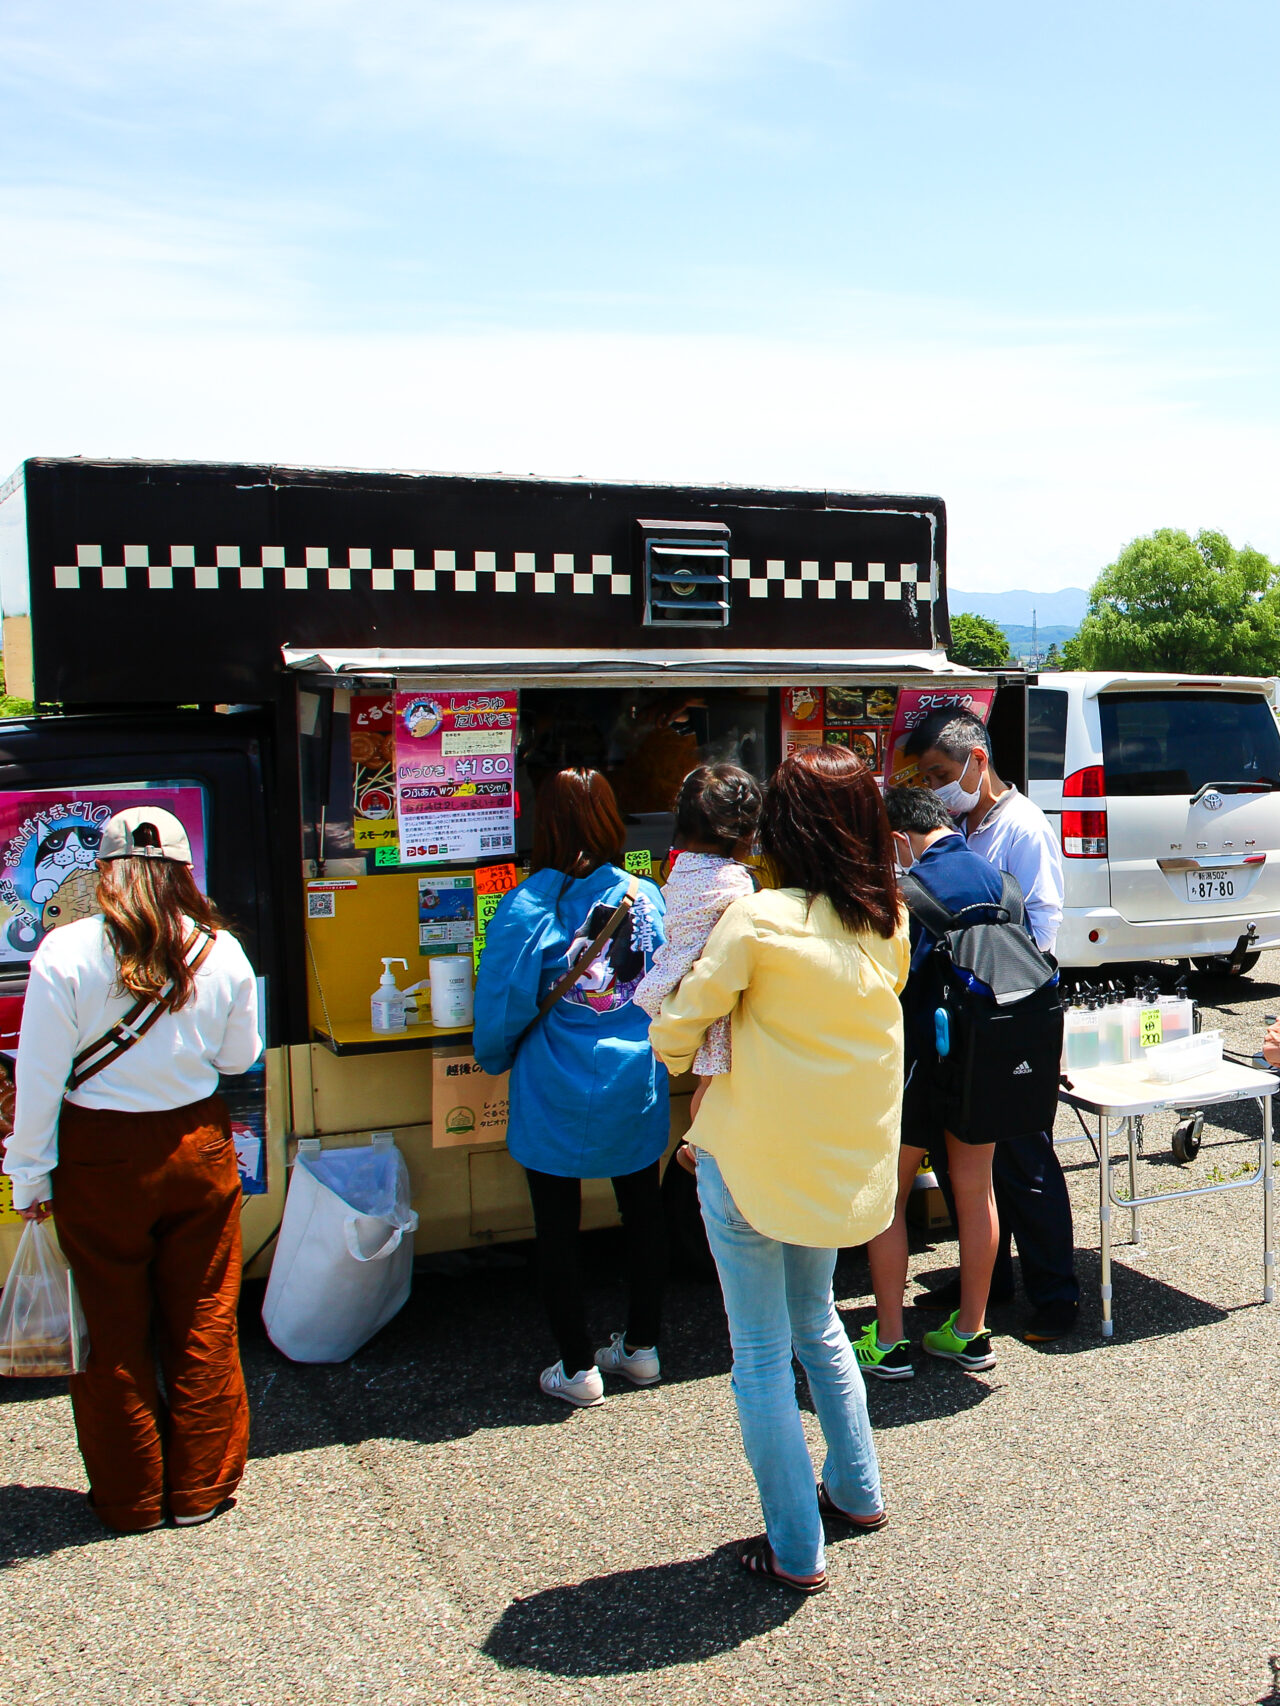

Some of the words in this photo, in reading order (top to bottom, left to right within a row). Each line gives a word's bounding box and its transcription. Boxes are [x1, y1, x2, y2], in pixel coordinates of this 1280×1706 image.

[450, 696, 505, 712] しょうゆ
[918, 693, 973, 709] タピオカ
[400, 765, 447, 780] いっぴき
[1199, 880, 1234, 898] 87-80
